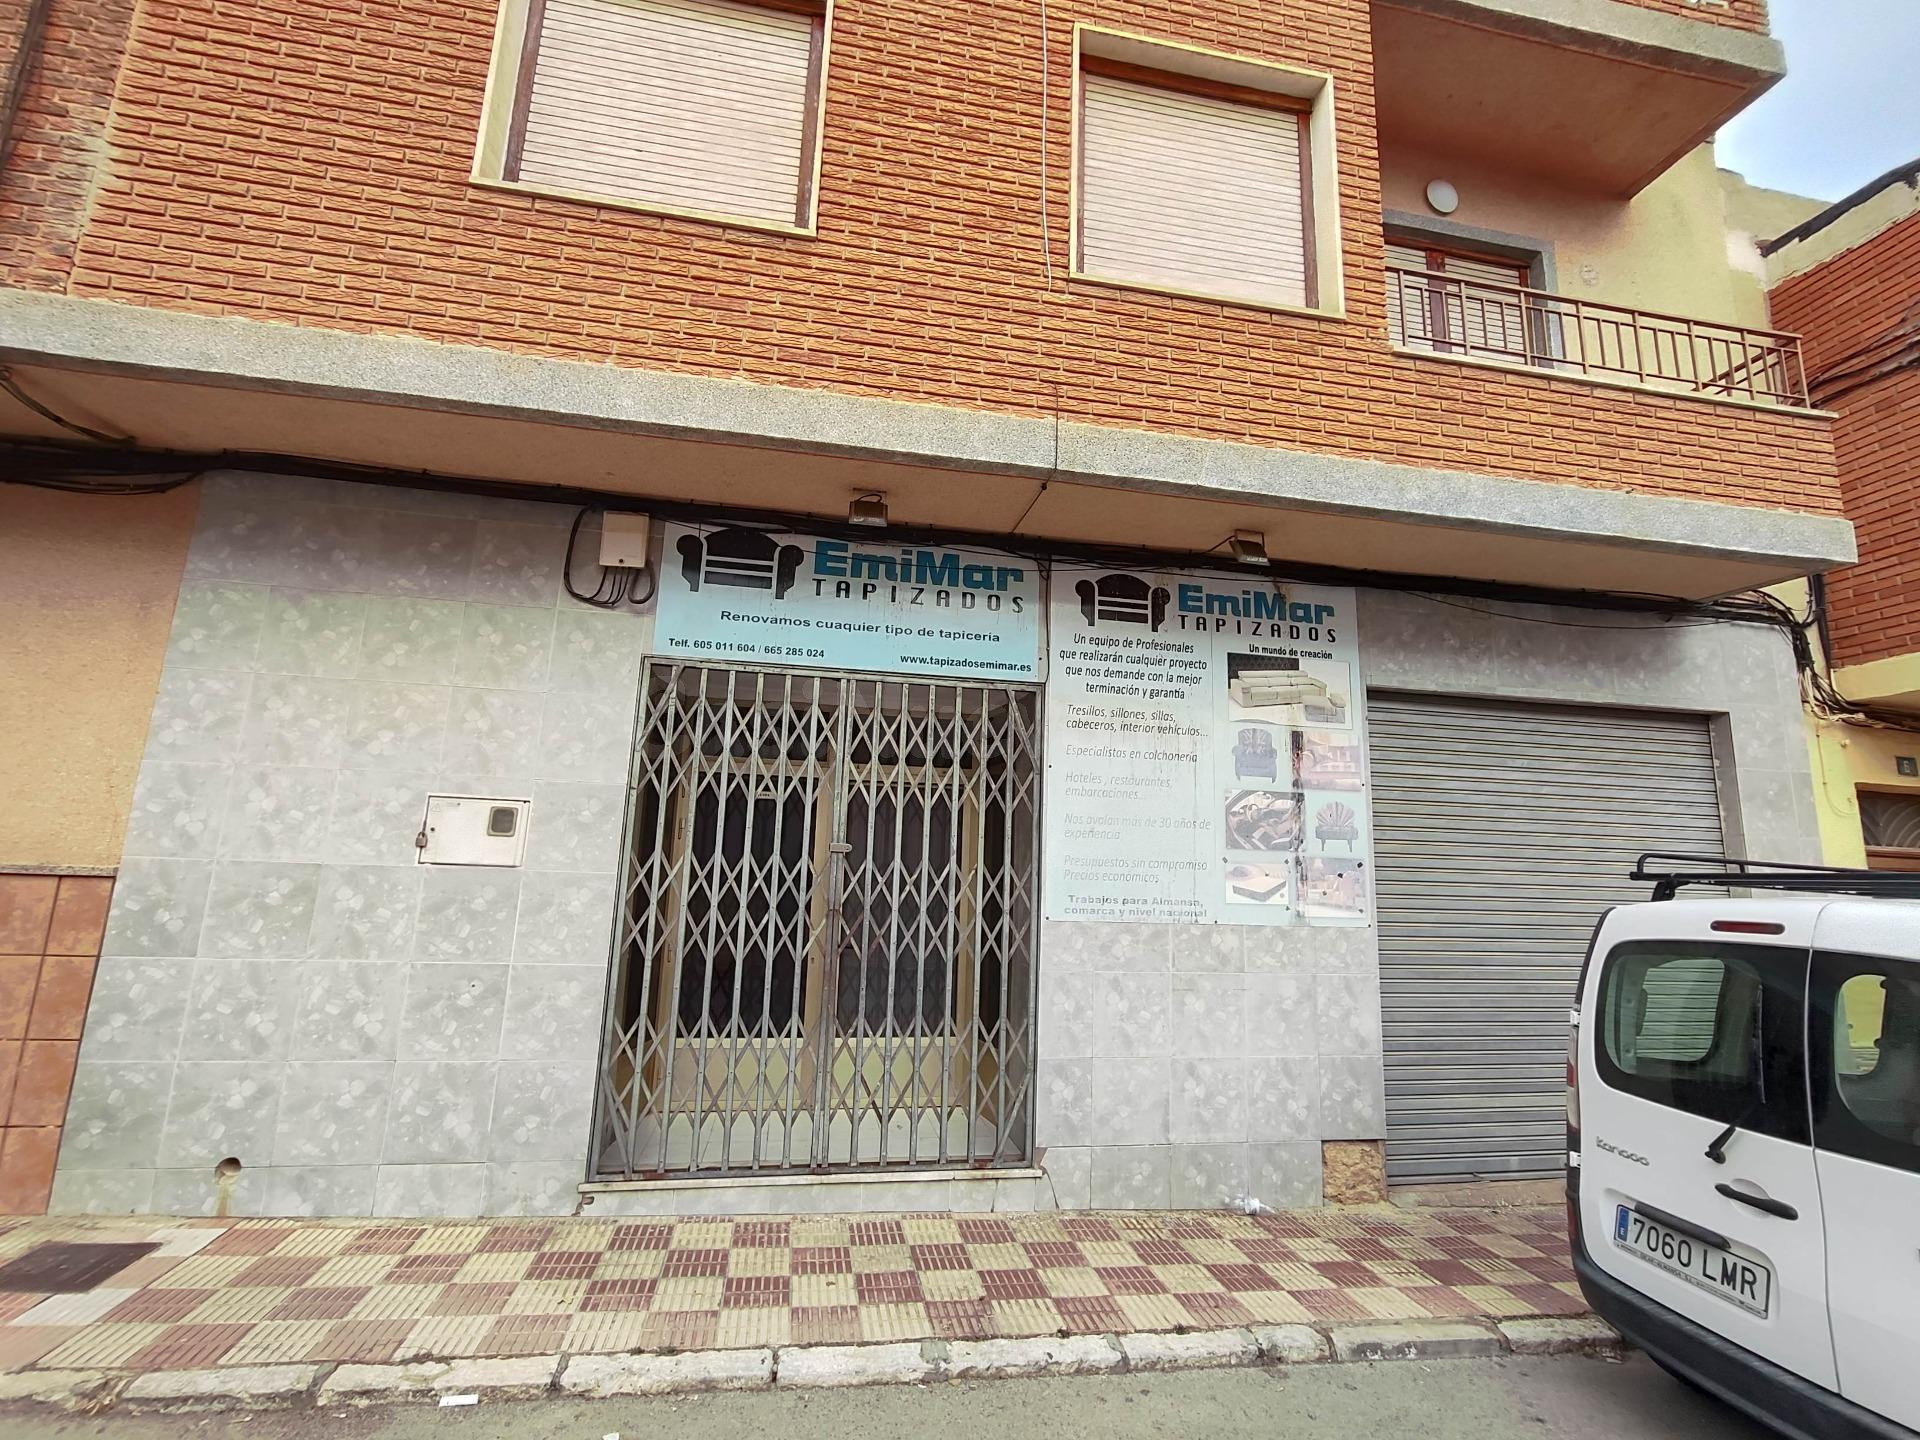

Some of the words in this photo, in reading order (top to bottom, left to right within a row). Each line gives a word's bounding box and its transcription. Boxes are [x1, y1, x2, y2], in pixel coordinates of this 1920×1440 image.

[814, 540, 1024, 592] EmiMar
[812, 578, 1024, 614] TAPIZADOS
[1178, 583, 1335, 625] EmiMar
[720, 610, 811, 628] Renovamos
[815, 618, 881, 634] cuaquier
[885, 623, 913, 639] tipo
[917, 626, 935, 638] de
[1178, 614, 1336, 643] TAPIZADOS
[668, 638, 690, 649] Telf.
[693, 639, 713, 650] 605
[715, 641, 735, 652] 011
[737, 643, 756, 653] 604
[757, 644, 762, 655] /
[764, 645, 784, 655] 665
[785, 646, 804, 657] 285
[806, 648, 825, 658] 024
[1073, 633, 1086, 645] Un
[1088, 635, 1120, 649] equipo
[1122, 637, 1134, 648] de
[1136, 638, 1194, 653] Profesionales
[1249, 643, 1260, 653] Un
[1262, 647, 1287, 655] mundo
[1289, 648, 1298, 656] de
[1300, 650, 1333, 659] creación
[900, 653, 1032, 673] www.tapizadosemimar.es
[1059, 649, 1077, 660] que
[1079, 650, 1123, 663] realizarán
[1125, 654, 1167, 667] cualquier
[1169, 658, 1207, 670] proyecto
[1065, 666, 1082, 677] que
[1085, 667, 1101, 677] nos
[1103, 667, 1145, 680] demande
[1147, 673, 1163, 682] con
[1166, 671, 1174, 683] la
[1176, 674, 1203, 687] mejor
[1086, 682, 1139, 696] terminación
[1142, 688, 1148, 698] y
[1149, 688, 1185, 700] garantía
[1067, 704, 1107, 718] Tresillos,
[1110, 708, 1148, 721] sillones,
[1150, 710, 1176, 723] sillas,
[1066, 718, 1117, 732] cabeceros,
[1120, 721, 1155, 734] interior
[1066, 744, 1127, 759] Especialistas
[1129, 750, 1141, 759] en
[1065, 786, 1139, 800] embarcaciones
[1064, 813, 1083, 825] Nos
[1159, 817, 1172, 829] 30
[1174, 818, 1196, 830] años
[1199, 819, 1212, 830] de
[1064, 855, 1129, 870] Presupuestos
[1130, 857, 1146, 869] sin
[1148, 860, 1208, 872] compromiso
[1064, 868, 1100, 881] Precios
[1068, 894, 1119, 906] Trabajos
[1122, 898, 1148, 906] para
[1064, 907, 1115, 916] comarca
[1118, 908, 1125, 917] y
[1128, 907, 1157, 917] nivel
[1159, 908, 1208, 919] nacional
[1633, 1216, 1692, 1268] 7060
[1702, 1249, 1758, 1301] LMR
